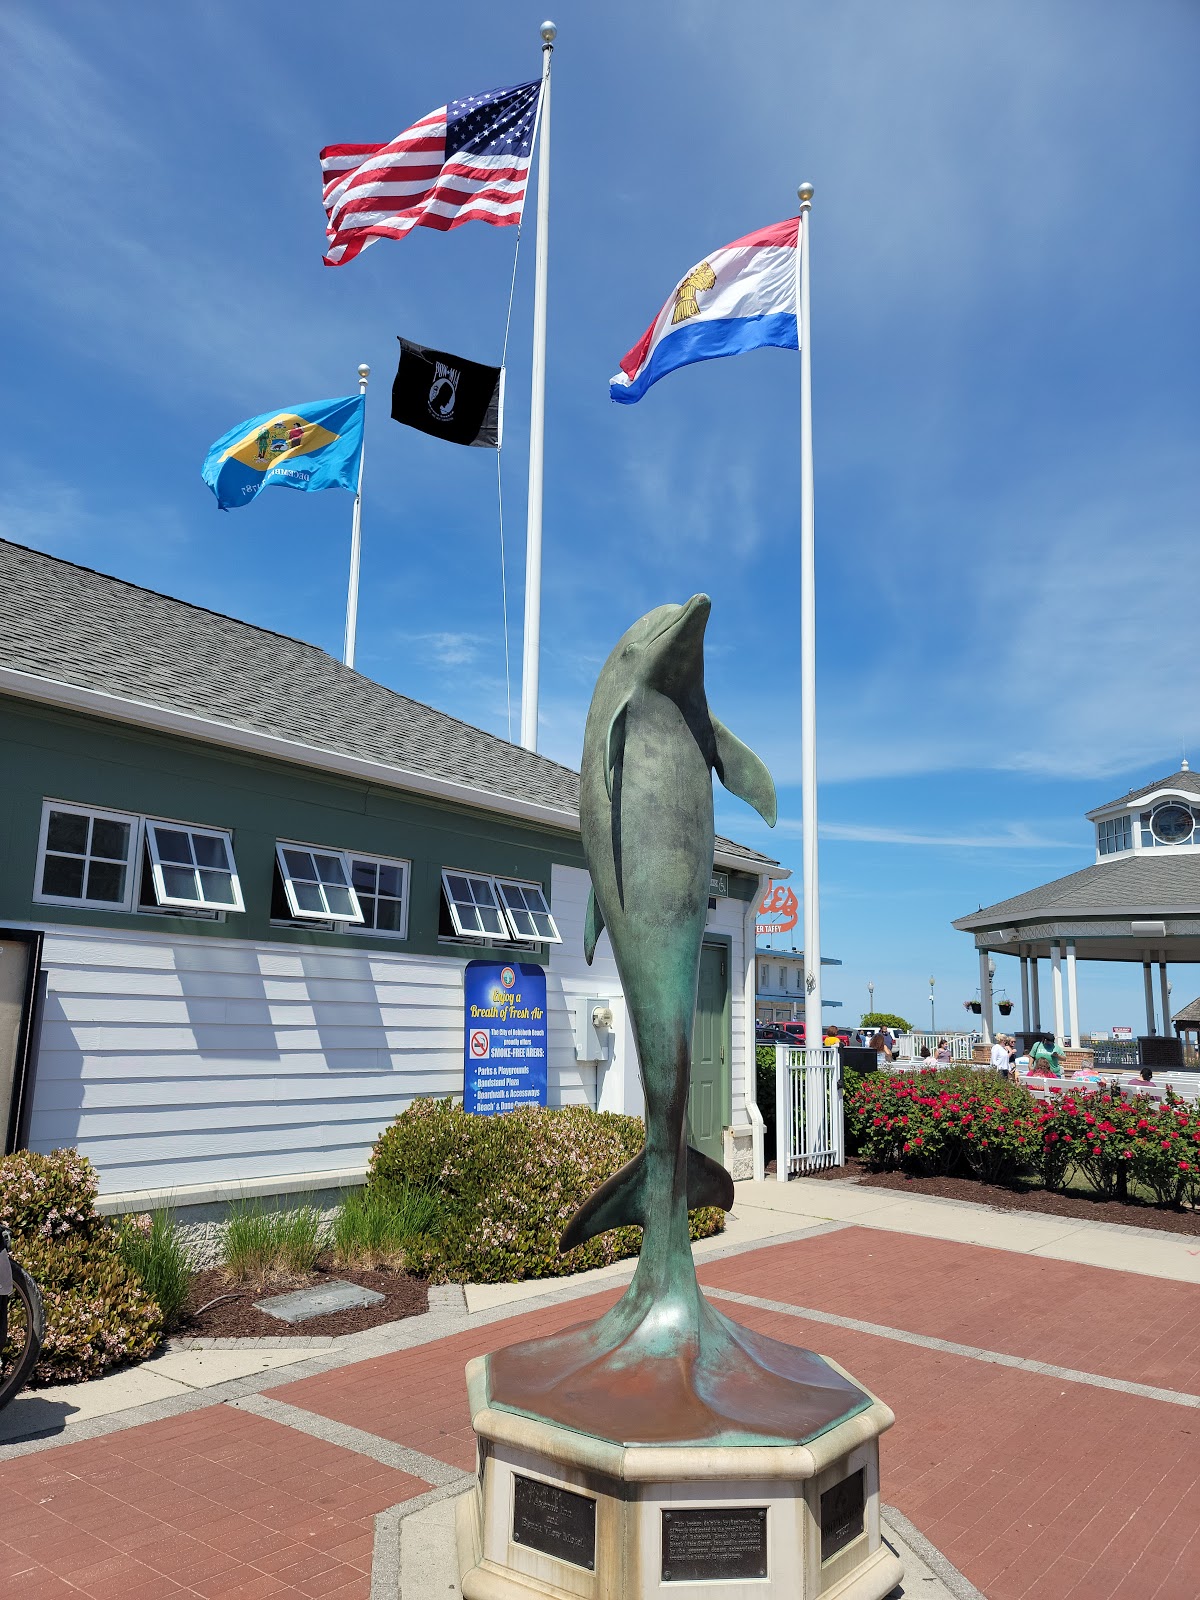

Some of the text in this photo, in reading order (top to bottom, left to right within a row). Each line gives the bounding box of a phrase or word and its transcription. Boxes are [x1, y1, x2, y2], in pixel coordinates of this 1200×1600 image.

[493, 989, 522, 1005] Enjoy a
[470, 1005, 543, 1021] Breath of Fresh Air
[532, 1029, 545, 1037] Beach
[491, 1047, 545, 1058] SMOKE-FREE AREAS:
[478, 1066, 493, 1075] Parks
[498, 1066, 530, 1075] Playgrounds
[477, 1078, 519, 1087] Bandstand Plaza
[477, 1090, 505, 1099] Boardwalk
[510, 1089, 540, 1098] Accessways
[501, 1101, 514, 1110] Dune
